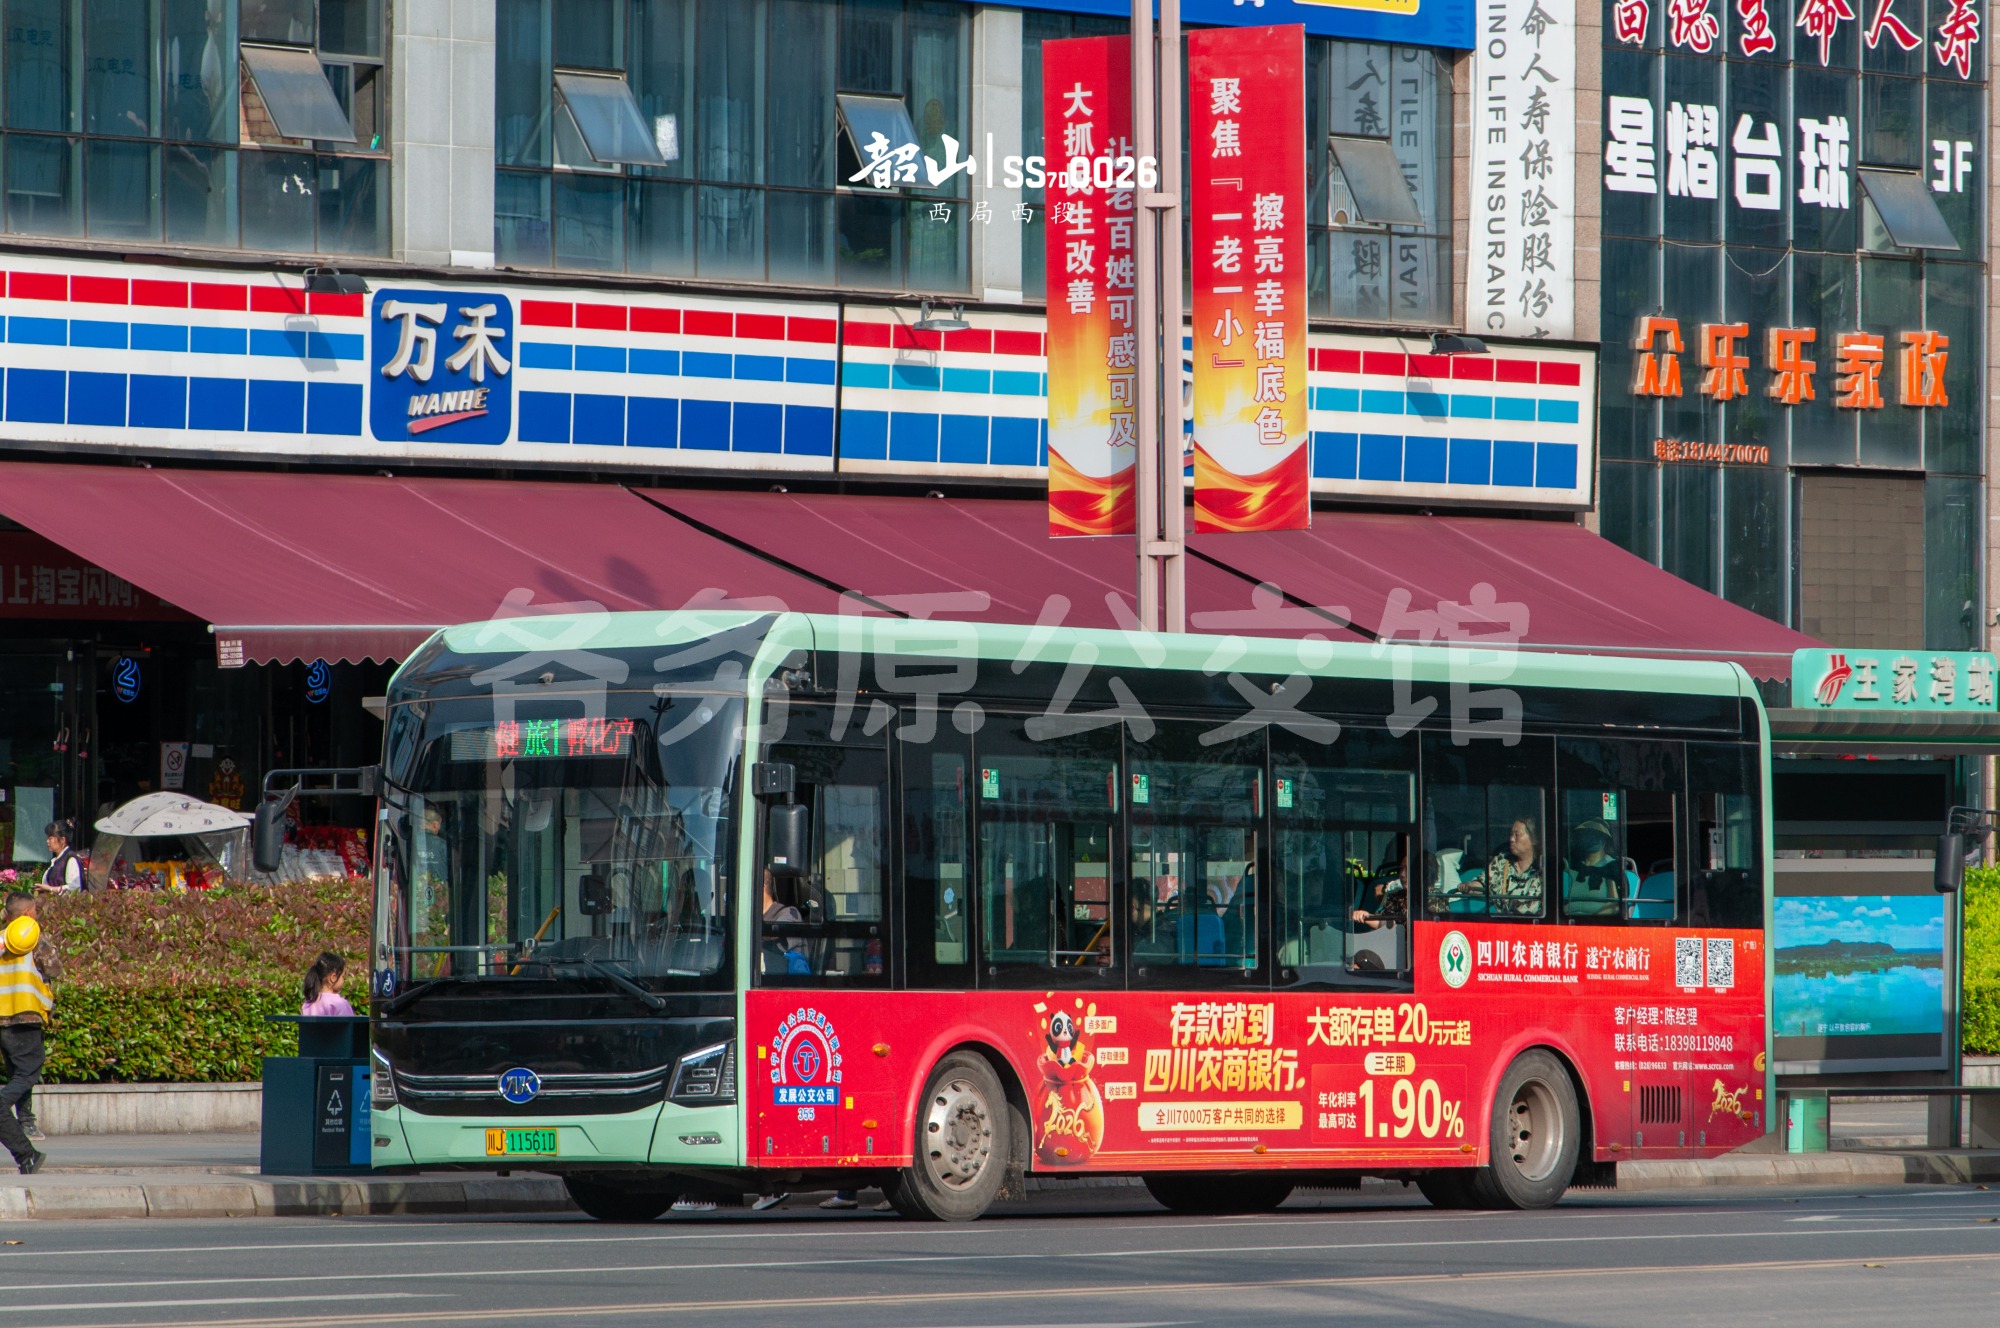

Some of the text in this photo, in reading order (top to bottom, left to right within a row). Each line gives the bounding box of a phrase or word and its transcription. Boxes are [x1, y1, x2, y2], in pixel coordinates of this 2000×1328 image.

[1488, 75, 1506, 145] LIFE
[1605, 95, 1973, 210] 星熠台球 3F
[1519, 0, 1560, 339] 命人寿保险股份
[1252, 193, 1286, 446] 擦亮幸福底色
[381, 299, 512, 383] 万禾
[1634, 316, 1949, 410] 众乐乐家政
[408, 388, 490, 417] WANHE
[1852, 656, 1994, 705] 王家湾站
[1476, 939, 1579, 970] 四川农商银行
[1585, 946, 1651, 971] 遂宁农商行
[1477, 972, 1579, 984] SICHUAN RURAL COMMERCIAL BANK
[1087, 1019, 1113, 1030] 点多面广
[1170, 1002, 1275, 1048] 存款就到
[1614, 1006, 1698, 1026] 客户经理:陈经理
[1614, 1033, 1734, 1052] 联系电话:18398119848
[1100, 1051, 1126, 1062] 存取便捷
[1374, 1055, 1406, 1073] 三年期
[1143, 1047, 1299, 1093] 四川农商银行
[778, 1088, 835, 1103] 发展公交公司
[1108, 1085, 1134, 1096] 收益实惠
[1318, 1091, 1357, 1108] 年化利率
[797, 1107, 816, 1121] 355
[1155, 1108, 1286, 1125] 全川7000万客户共同的选择
[1318, 1112, 1357, 1129] 最高可达
[1358, 1078, 1465, 1139] 1.90%
